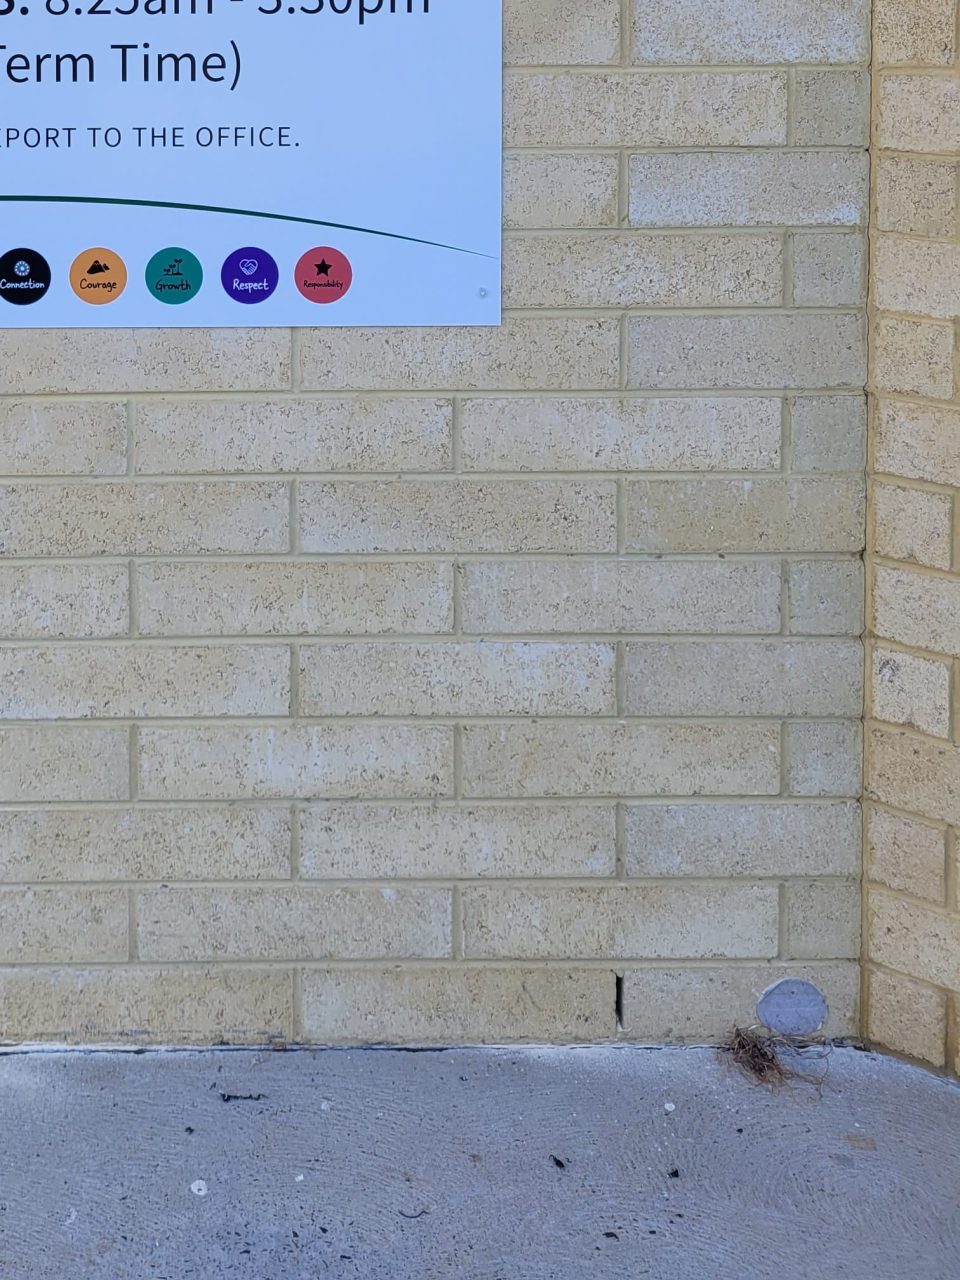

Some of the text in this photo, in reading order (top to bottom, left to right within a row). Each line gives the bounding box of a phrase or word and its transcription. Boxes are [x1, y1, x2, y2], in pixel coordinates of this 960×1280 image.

[111, 40, 241, 91] Time)
[86, 127, 122, 148] TO
[132, 127, 185, 148] THE
[195, 126, 301, 148] OFFICE.
[0, 278, 45, 290] Connection
[79, 278, 118, 293] Courage
[155, 279, 191, 292] Growth
[232, 278, 270, 293] Respect
[303, 279, 344, 291] Responsibility
